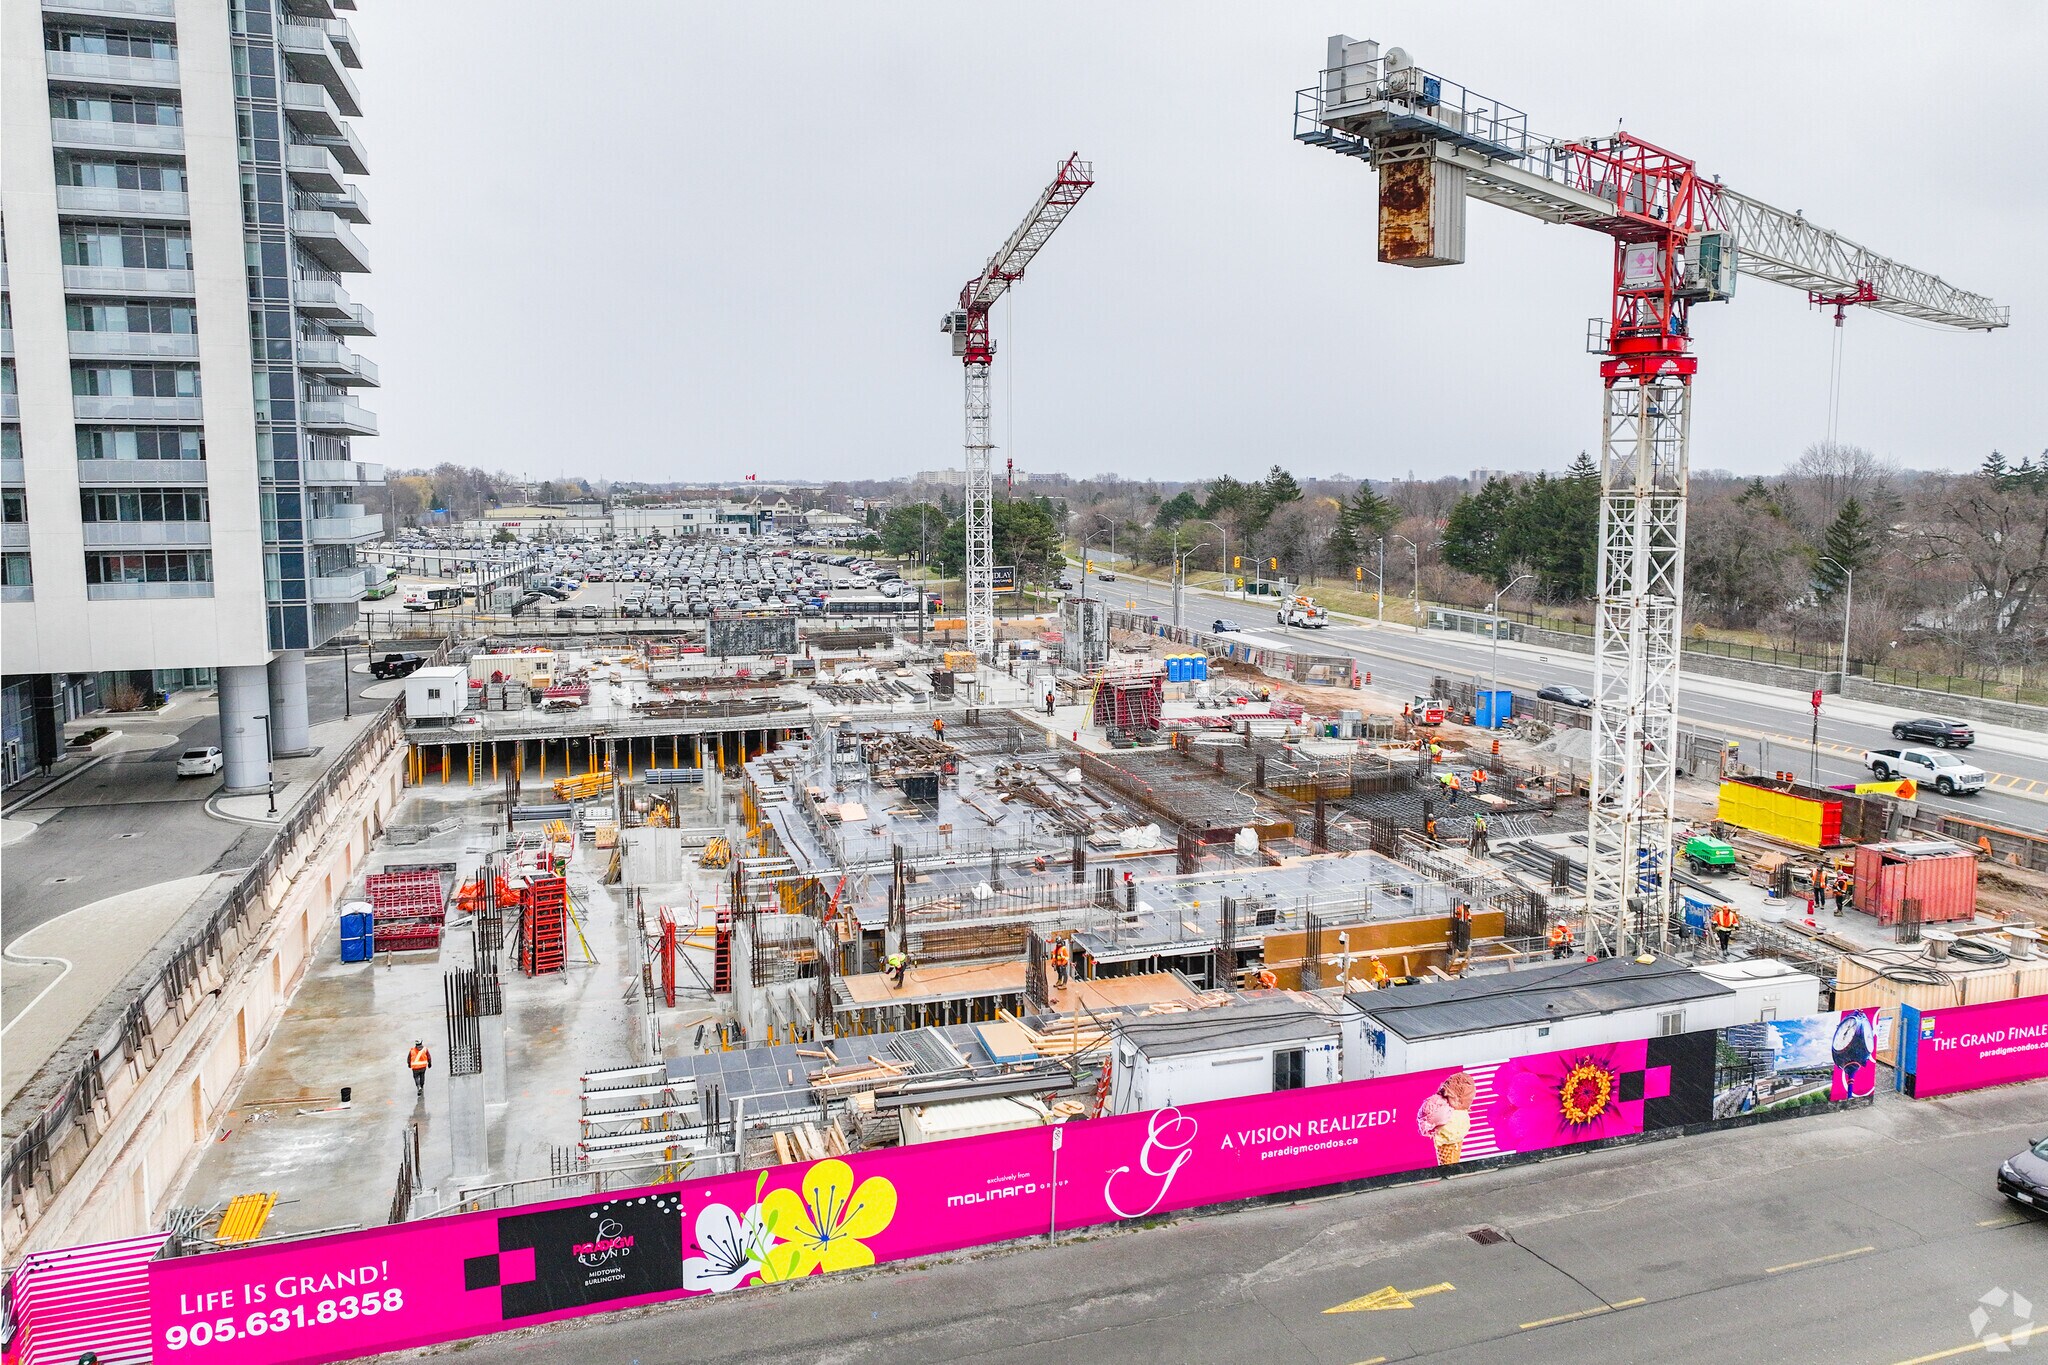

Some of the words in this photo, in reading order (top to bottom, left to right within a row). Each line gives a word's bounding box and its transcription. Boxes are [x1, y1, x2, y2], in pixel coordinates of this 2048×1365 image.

[1933, 1037, 1957, 1051] THE
[1960, 1031, 2005, 1047] GRAND
[2008, 1024, 2048, 1041] FINALE
[1980, 1042, 2048, 1059] paradigmcondos.ca
[1220, 1133, 1234, 1150] A
[1238, 1122, 1302, 1147] VISION
[1307, 1108, 1398, 1136] REALIZED!
[1261, 1137, 1359, 1160] paradigmcondos.ca
[987, 1174, 1017, 1184] exclusively
[578, 1248, 630, 1263] GRAND
[585, 1274, 626, 1286] BURLINGTON
[589, 1267, 621, 1278] MIDTOWN
[180, 1289, 234, 1316] LIFE
[244, 1283, 267, 1305] IS
[274, 1260, 388, 1299] GRAND!
[165, 1288, 404, 1351] 905.631.8358
